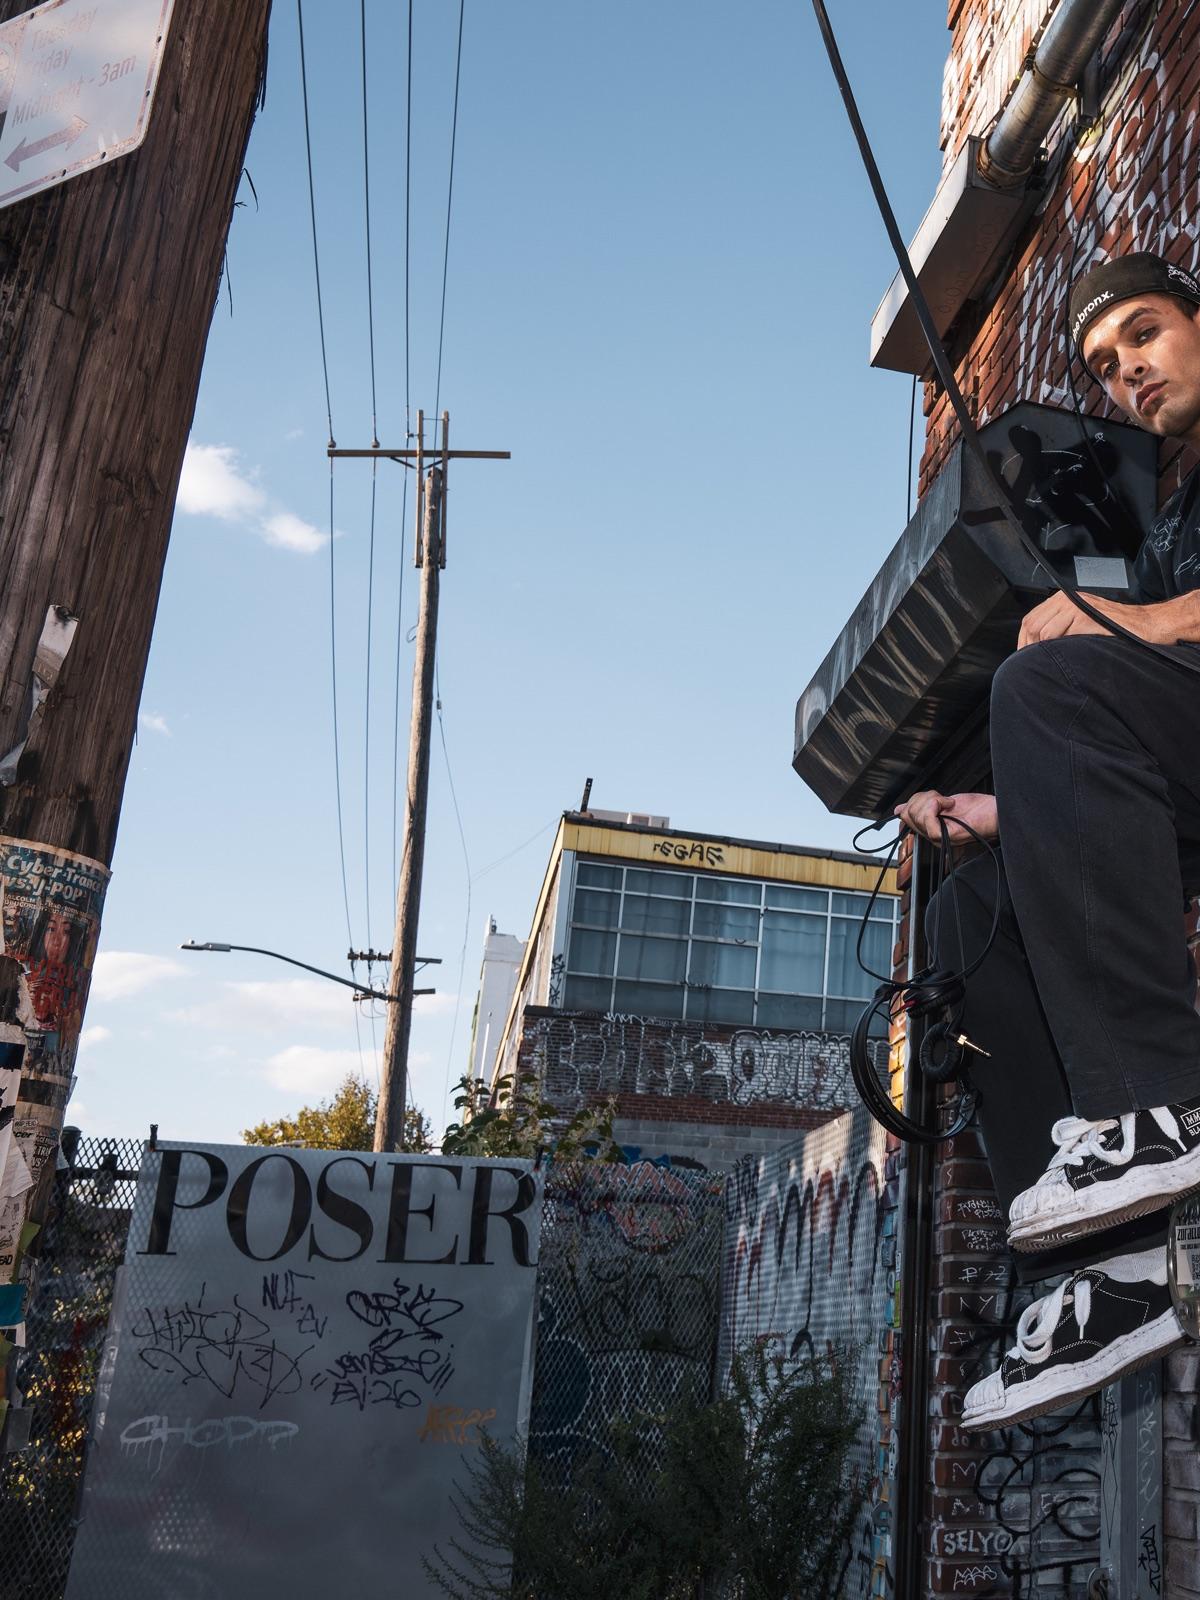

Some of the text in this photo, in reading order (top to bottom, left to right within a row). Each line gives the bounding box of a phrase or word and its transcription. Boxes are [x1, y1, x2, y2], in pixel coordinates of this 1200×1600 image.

[98, 55, 137, 87] 3am
[1077, 290, 1114, 324] bronx.
[136, 1149, 539, 1268] POSER
